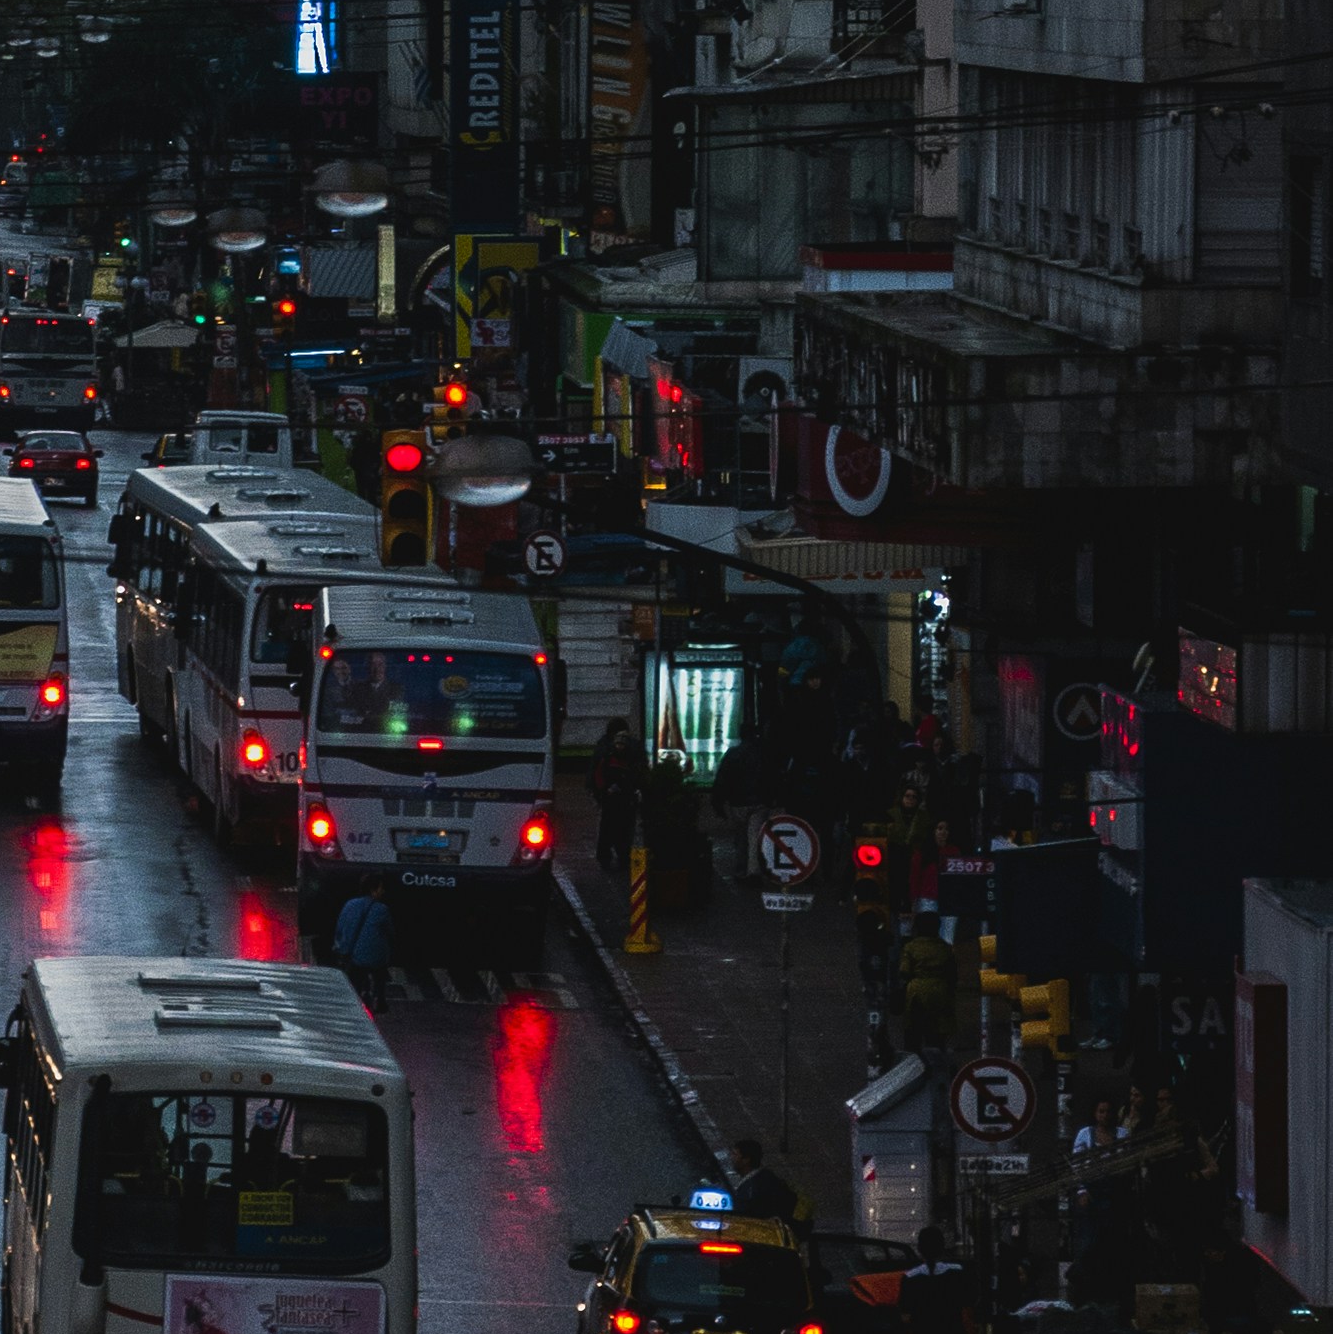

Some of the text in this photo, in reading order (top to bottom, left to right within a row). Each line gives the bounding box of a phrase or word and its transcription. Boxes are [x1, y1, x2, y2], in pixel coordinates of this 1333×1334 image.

[300, 87, 373, 106] EXPO
[401, 870, 457, 889] Cutcsa
[279, 1234, 328, 1245] ANCAP
